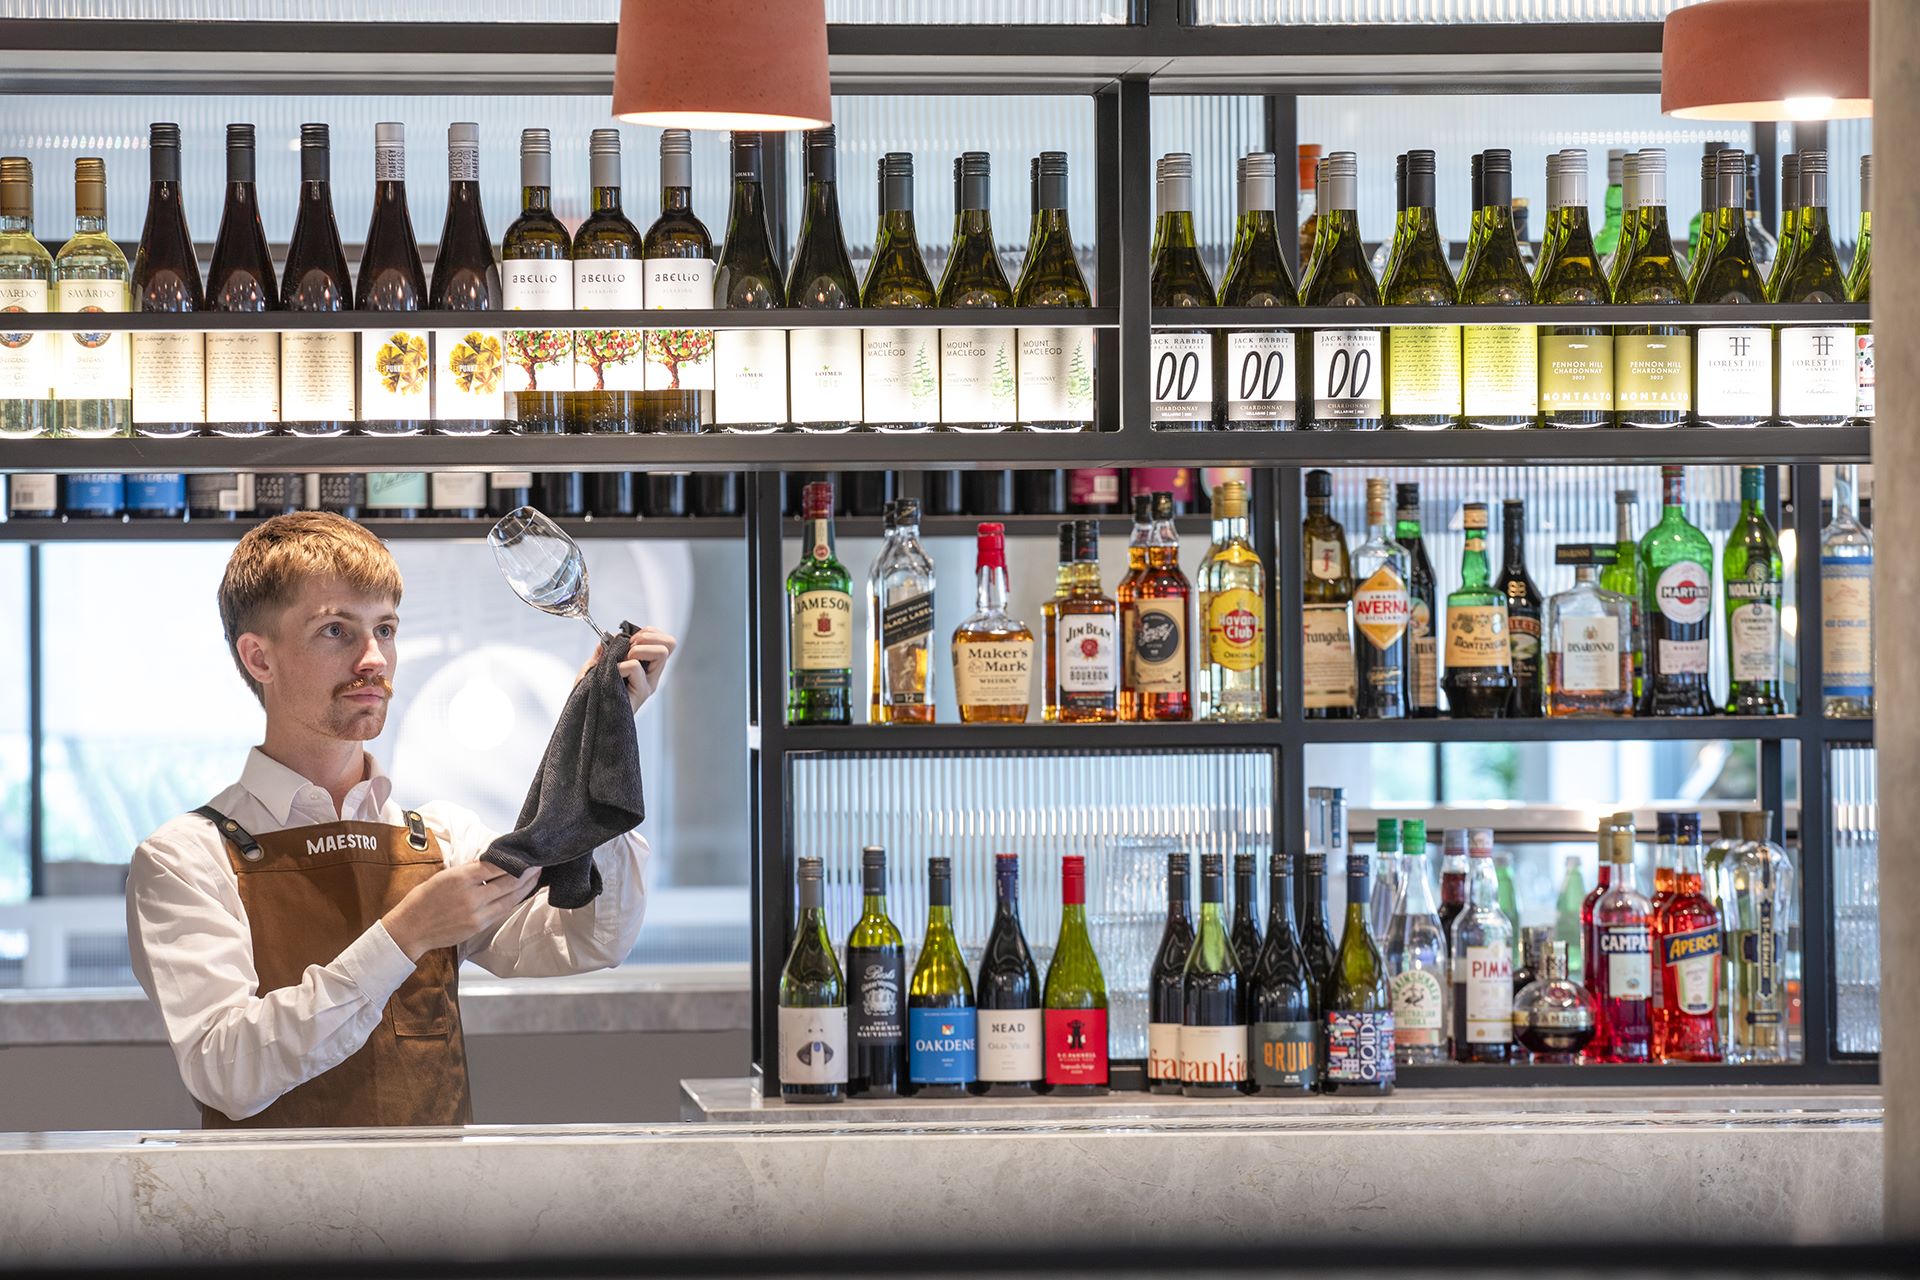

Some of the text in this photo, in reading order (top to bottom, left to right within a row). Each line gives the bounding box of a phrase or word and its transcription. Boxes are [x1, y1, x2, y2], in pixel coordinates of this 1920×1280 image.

[388, 149, 397, 178] CHAFFEY
[868, 341, 893, 349] MOUNT
[946, 341, 971, 349] MOUNT
[1023, 340, 1048, 348] MOUNT
[868, 349, 906, 357] MACLEOD
[946, 349, 985, 357] MACLEOD
[1023, 348, 1062, 356] MACLEOD
[1543, 392, 1611, 401] MONTALTO
[1621, 392, 1689, 401] MONTALTO
[1661, 586, 1709, 598] MARTINI
[1728, 583, 1762, 597] NOILLY
[796, 596, 850, 615] JAMESON
[1356, 600, 1409, 615] AVERNA
[883, 607, 934, 630] BLACK LABEL
[1066, 622, 1111, 643] JIM BEAM
[1226, 626, 1253, 639] Club
[968, 647, 1028, 659] Maker's
[1567, 642, 1615, 653] DISARONNO
[985, 661, 1027, 672] Mark
[1070, 671, 1109, 681] BOURBON
[904, 694, 915, 703] 12
[306, 833, 377, 856] MAESTRO
[1669, 932, 1720, 960] APEROL
[915, 1038, 976, 1052] OAKDENE
